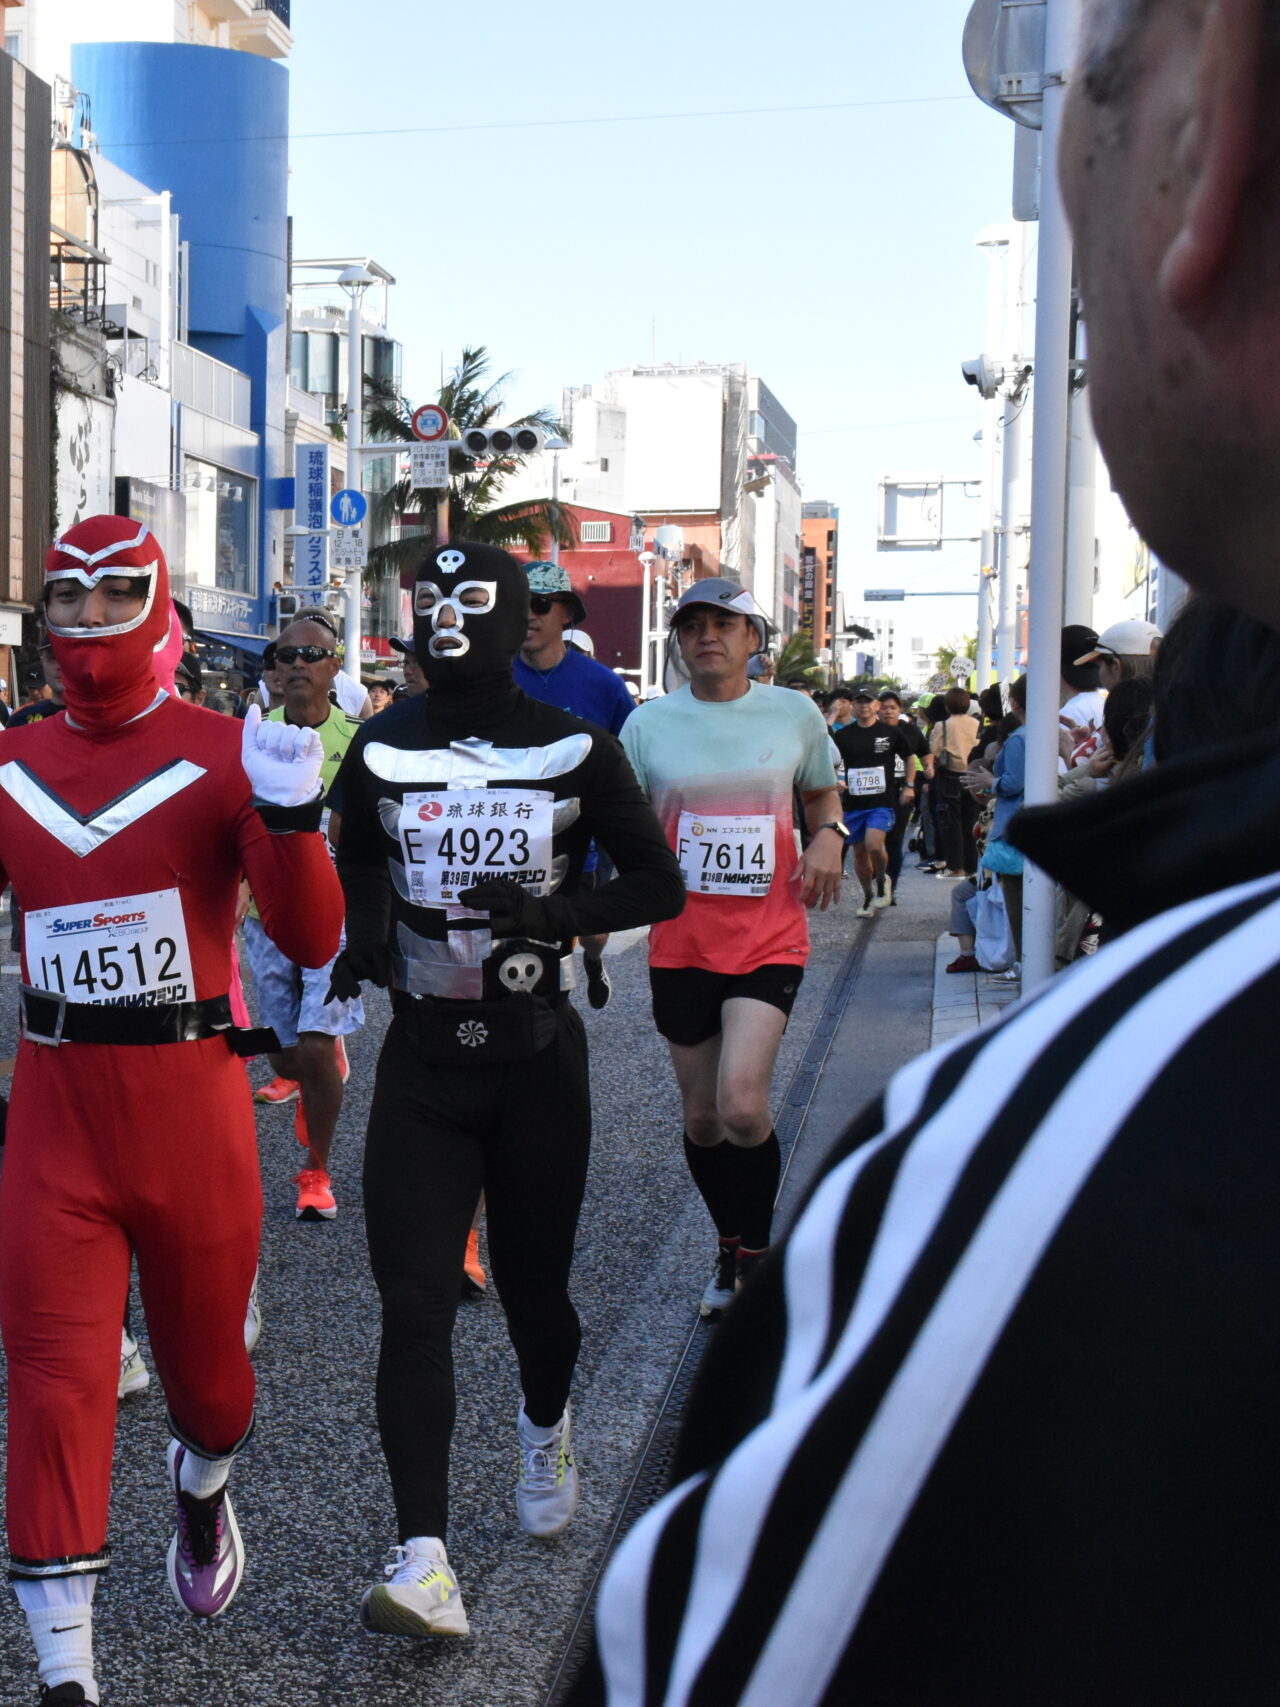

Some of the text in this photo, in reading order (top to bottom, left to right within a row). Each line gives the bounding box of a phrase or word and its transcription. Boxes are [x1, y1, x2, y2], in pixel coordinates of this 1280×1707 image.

[856, 776, 880, 787] 6798
[447, 801, 534, 819] 琉球銀行
[403, 827, 530, 866] E 4923
[678, 837, 766, 870] F 7614
[440, 871, 469, 886] 第39回
[53, 918, 92, 933] SUPER
[93, 911, 146, 928] SPORTS
